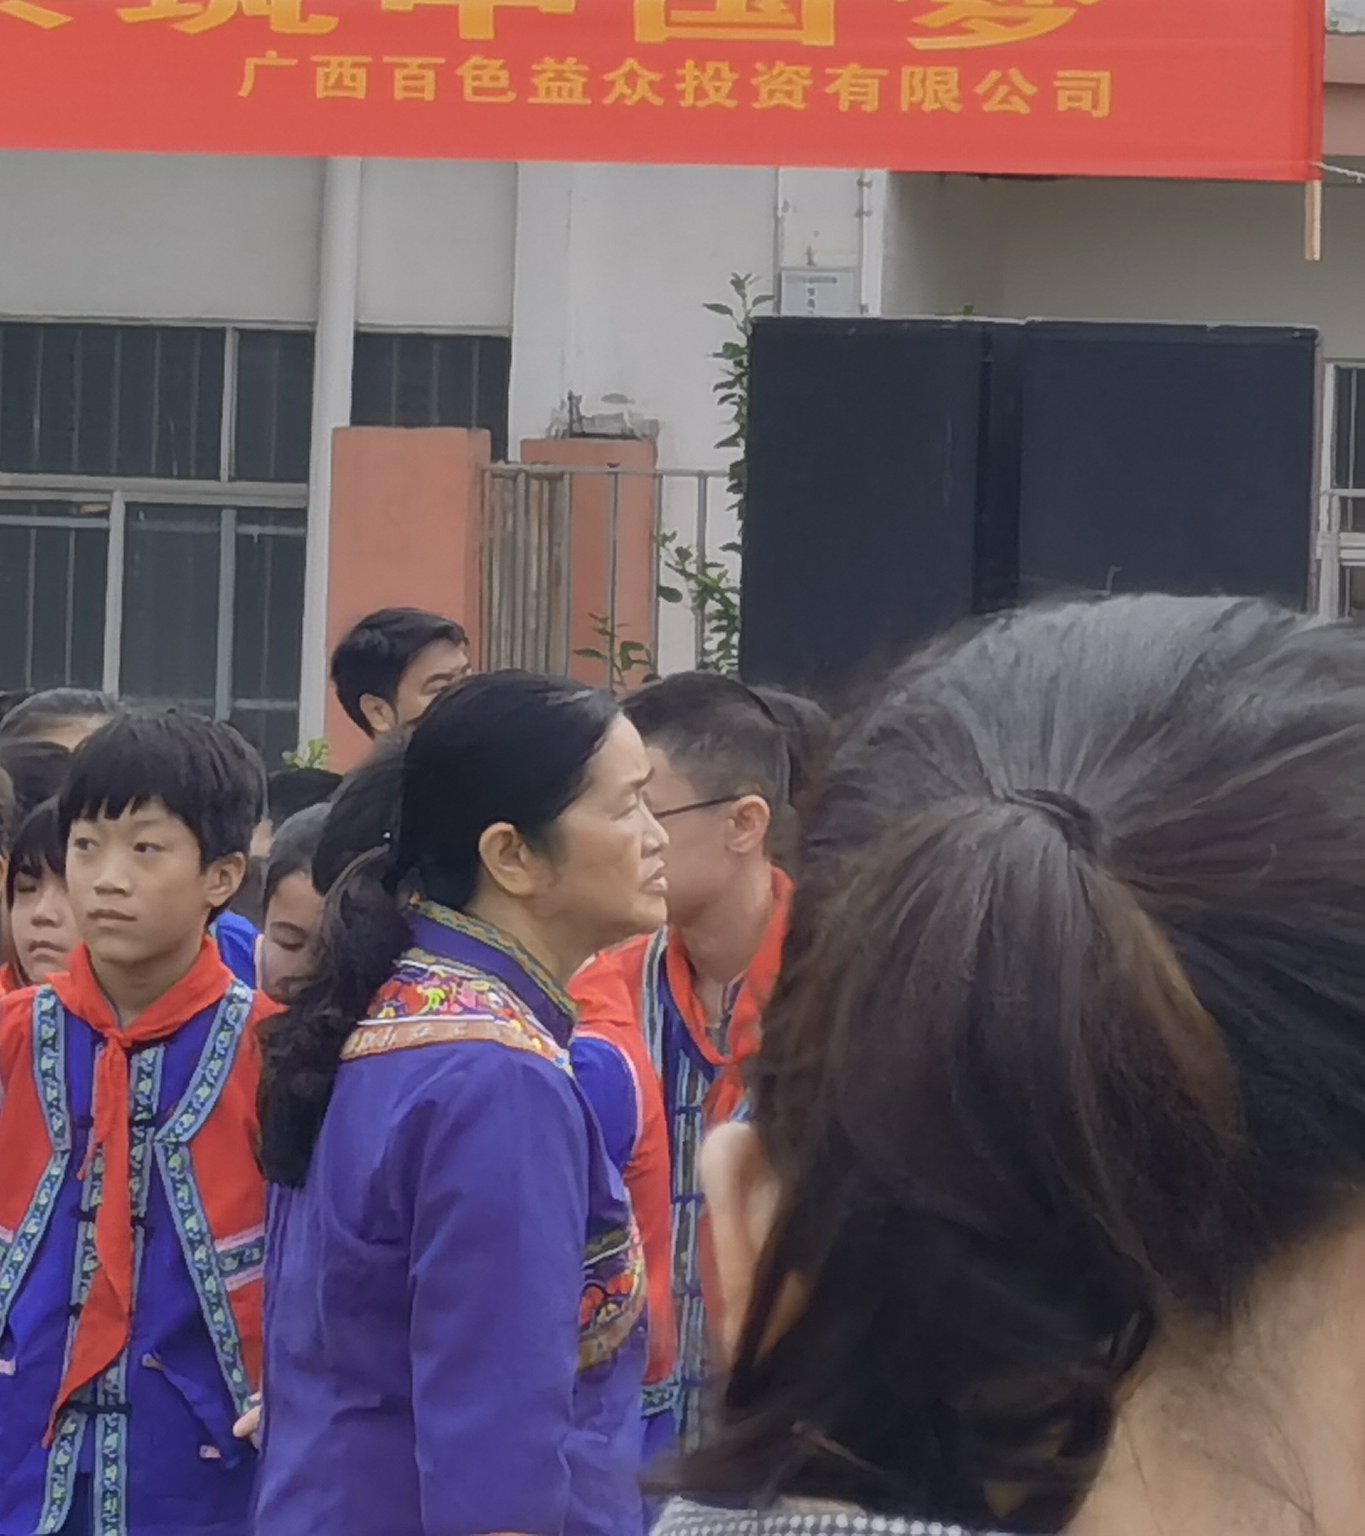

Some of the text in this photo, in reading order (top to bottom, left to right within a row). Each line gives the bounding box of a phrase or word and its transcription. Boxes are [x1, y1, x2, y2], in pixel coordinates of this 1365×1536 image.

[237, 50, 1114, 120] 广西百色益众投资有限公司
